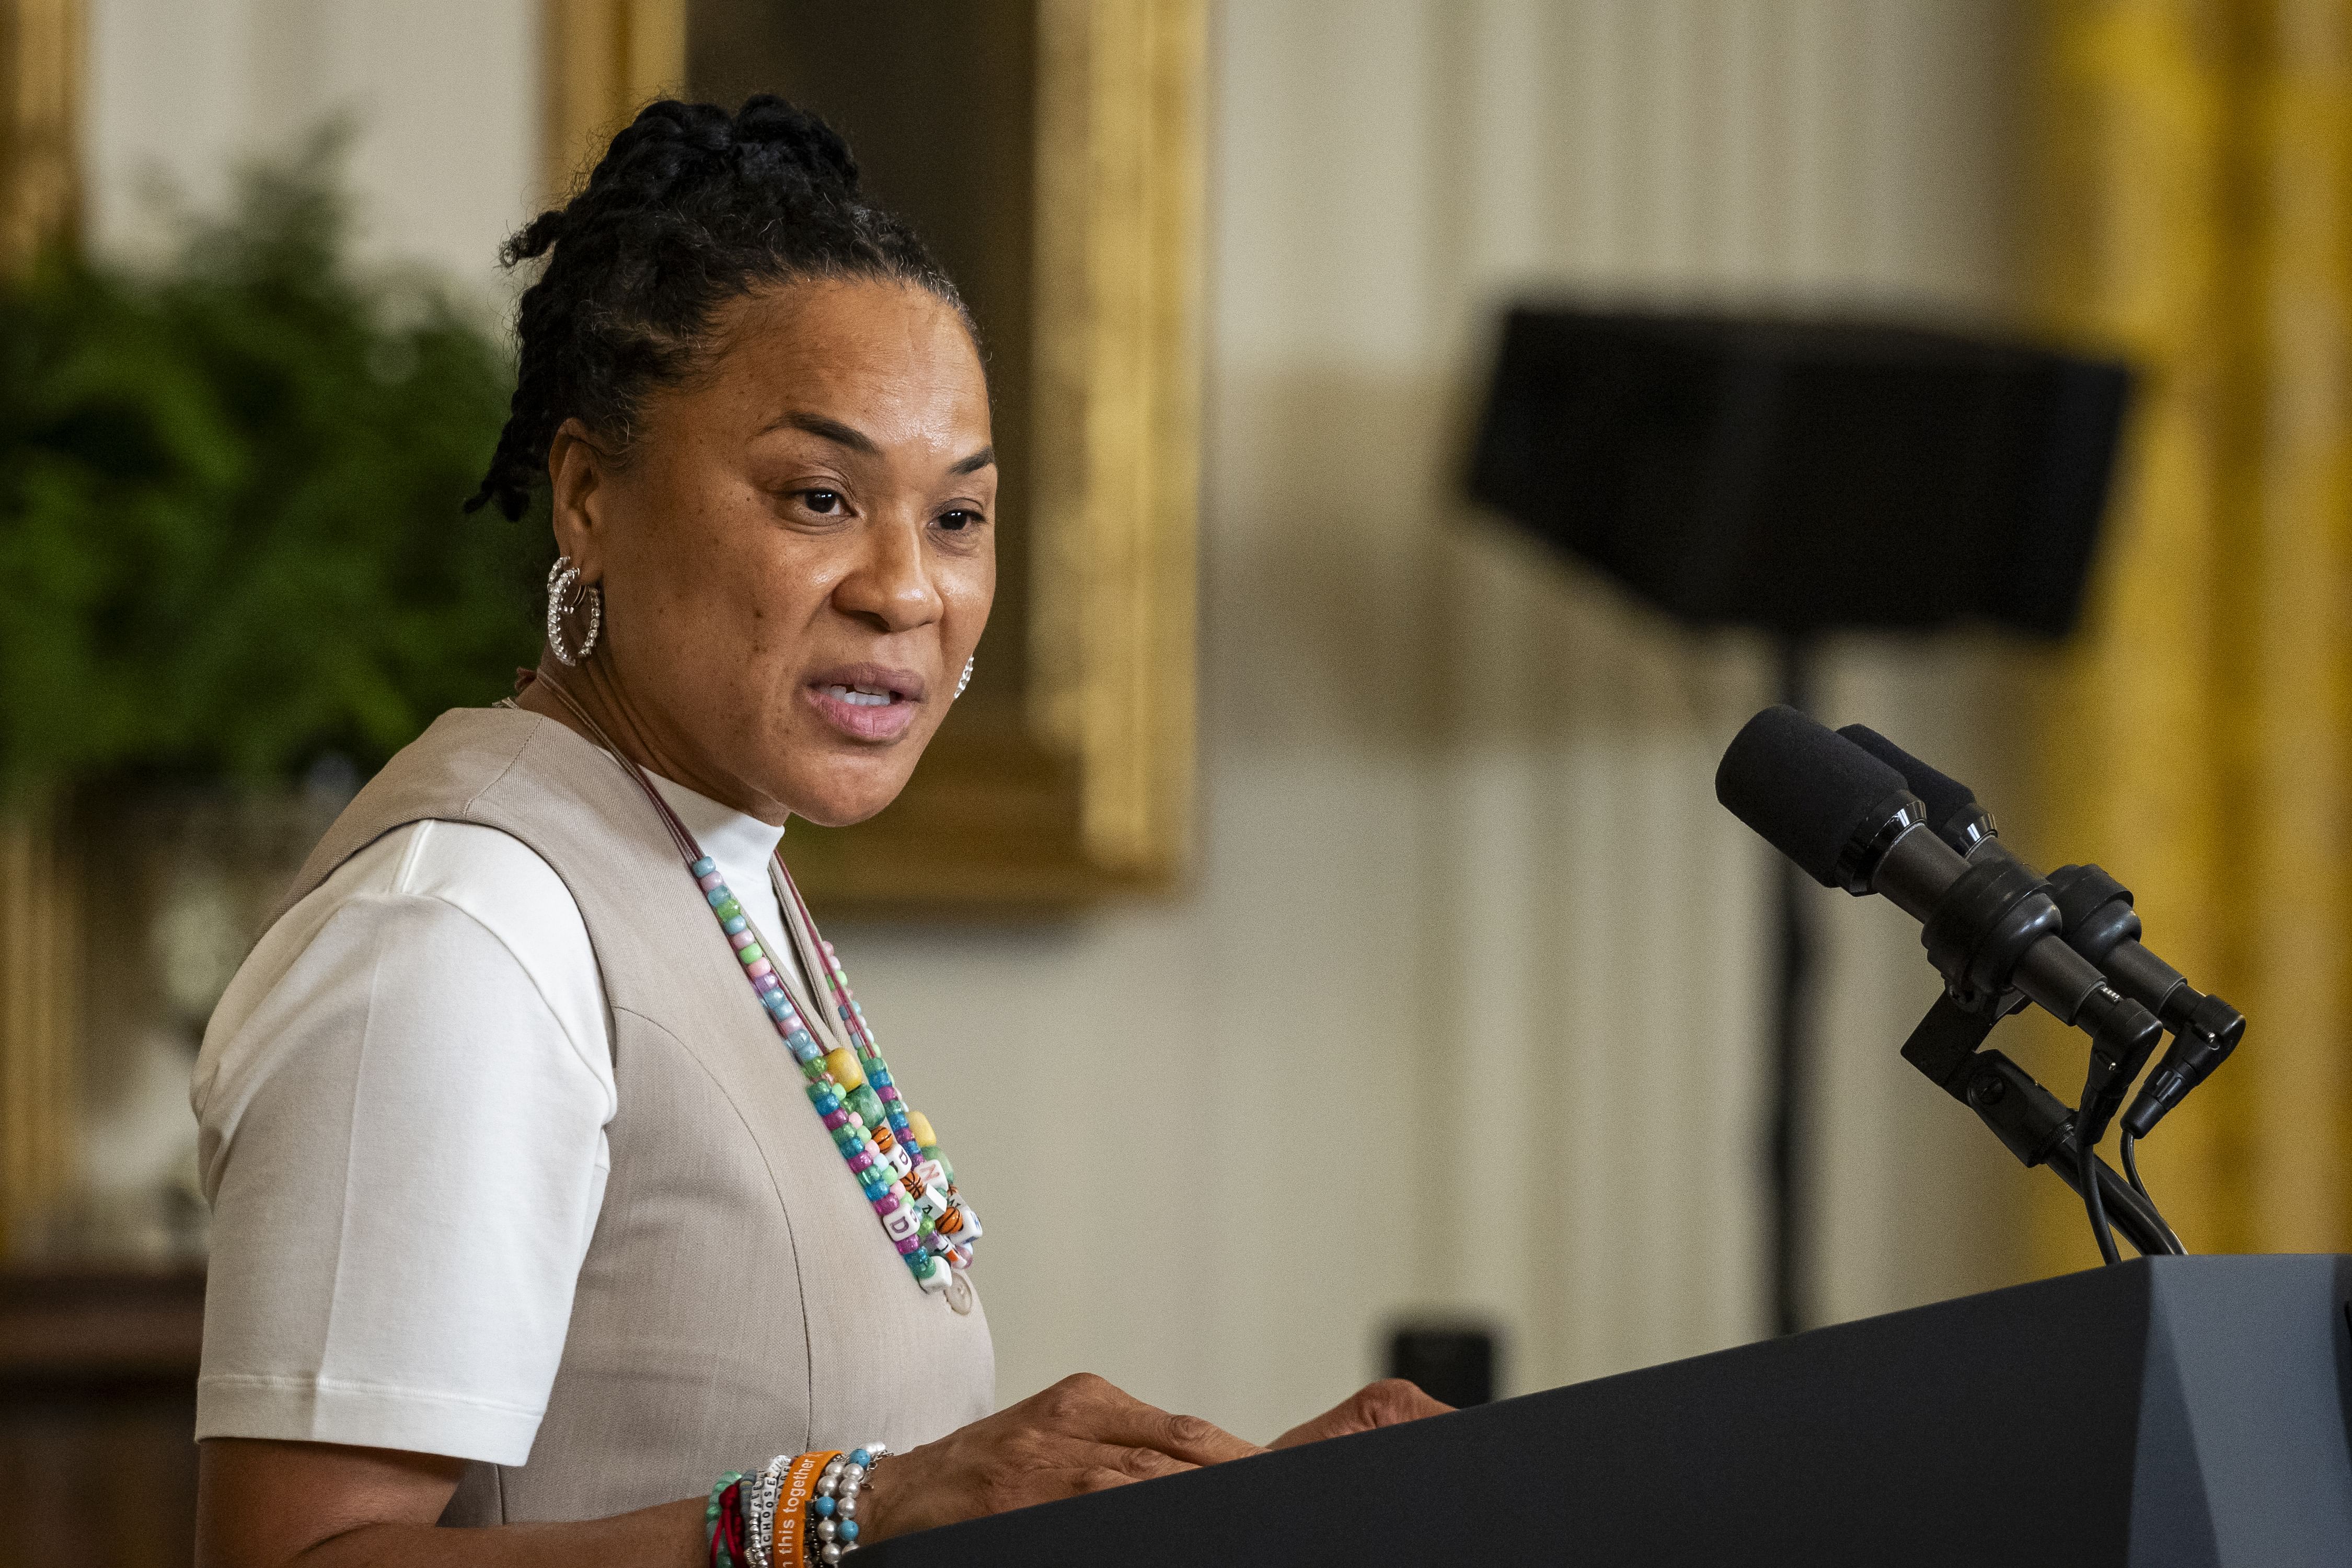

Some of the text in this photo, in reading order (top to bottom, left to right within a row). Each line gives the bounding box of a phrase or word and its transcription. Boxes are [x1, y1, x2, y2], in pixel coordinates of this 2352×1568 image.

[890, 1216, 909, 1234] D
[782, 1459, 815, 1513] together
[763, 1479, 776, 1542] CHOOSE
[778, 1519, 795, 1554] this
